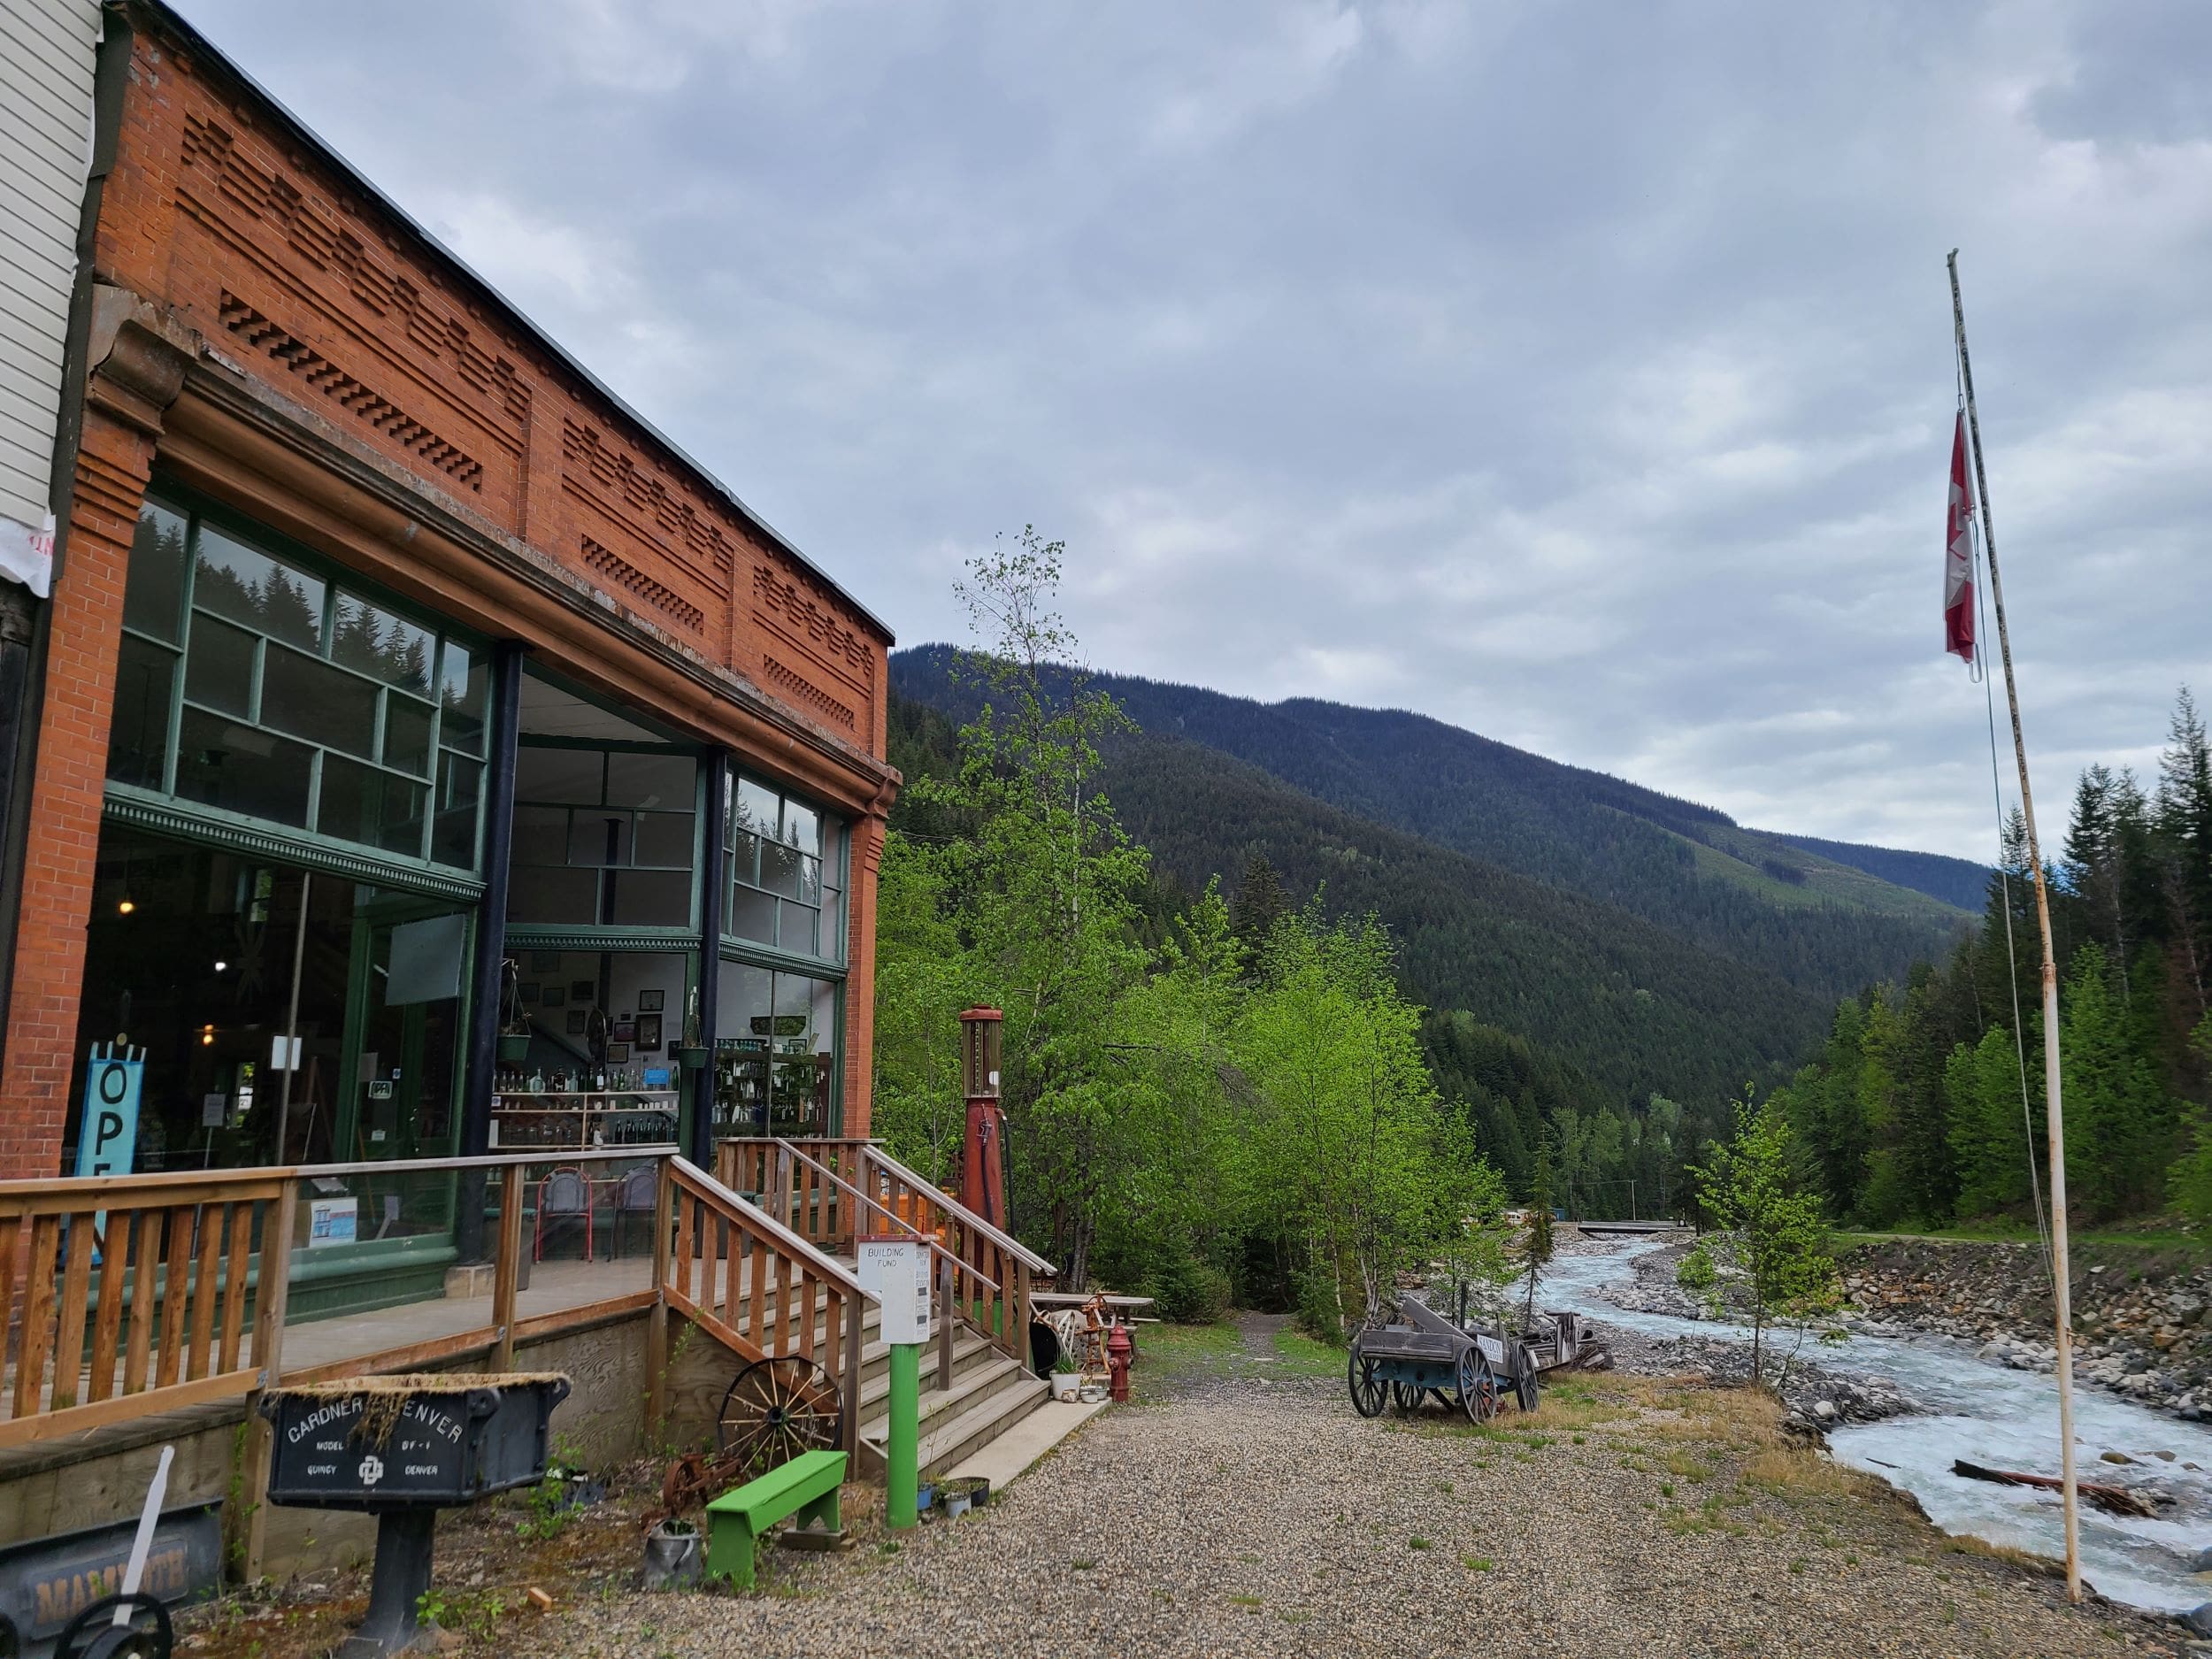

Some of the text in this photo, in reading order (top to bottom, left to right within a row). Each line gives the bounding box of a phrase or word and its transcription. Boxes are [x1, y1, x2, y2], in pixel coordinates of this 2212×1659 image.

[867, 1248, 904, 1258] BUILDING
[316, 1440, 345, 1451] MODEL
[404, 1464, 439, 1476] DENVER
